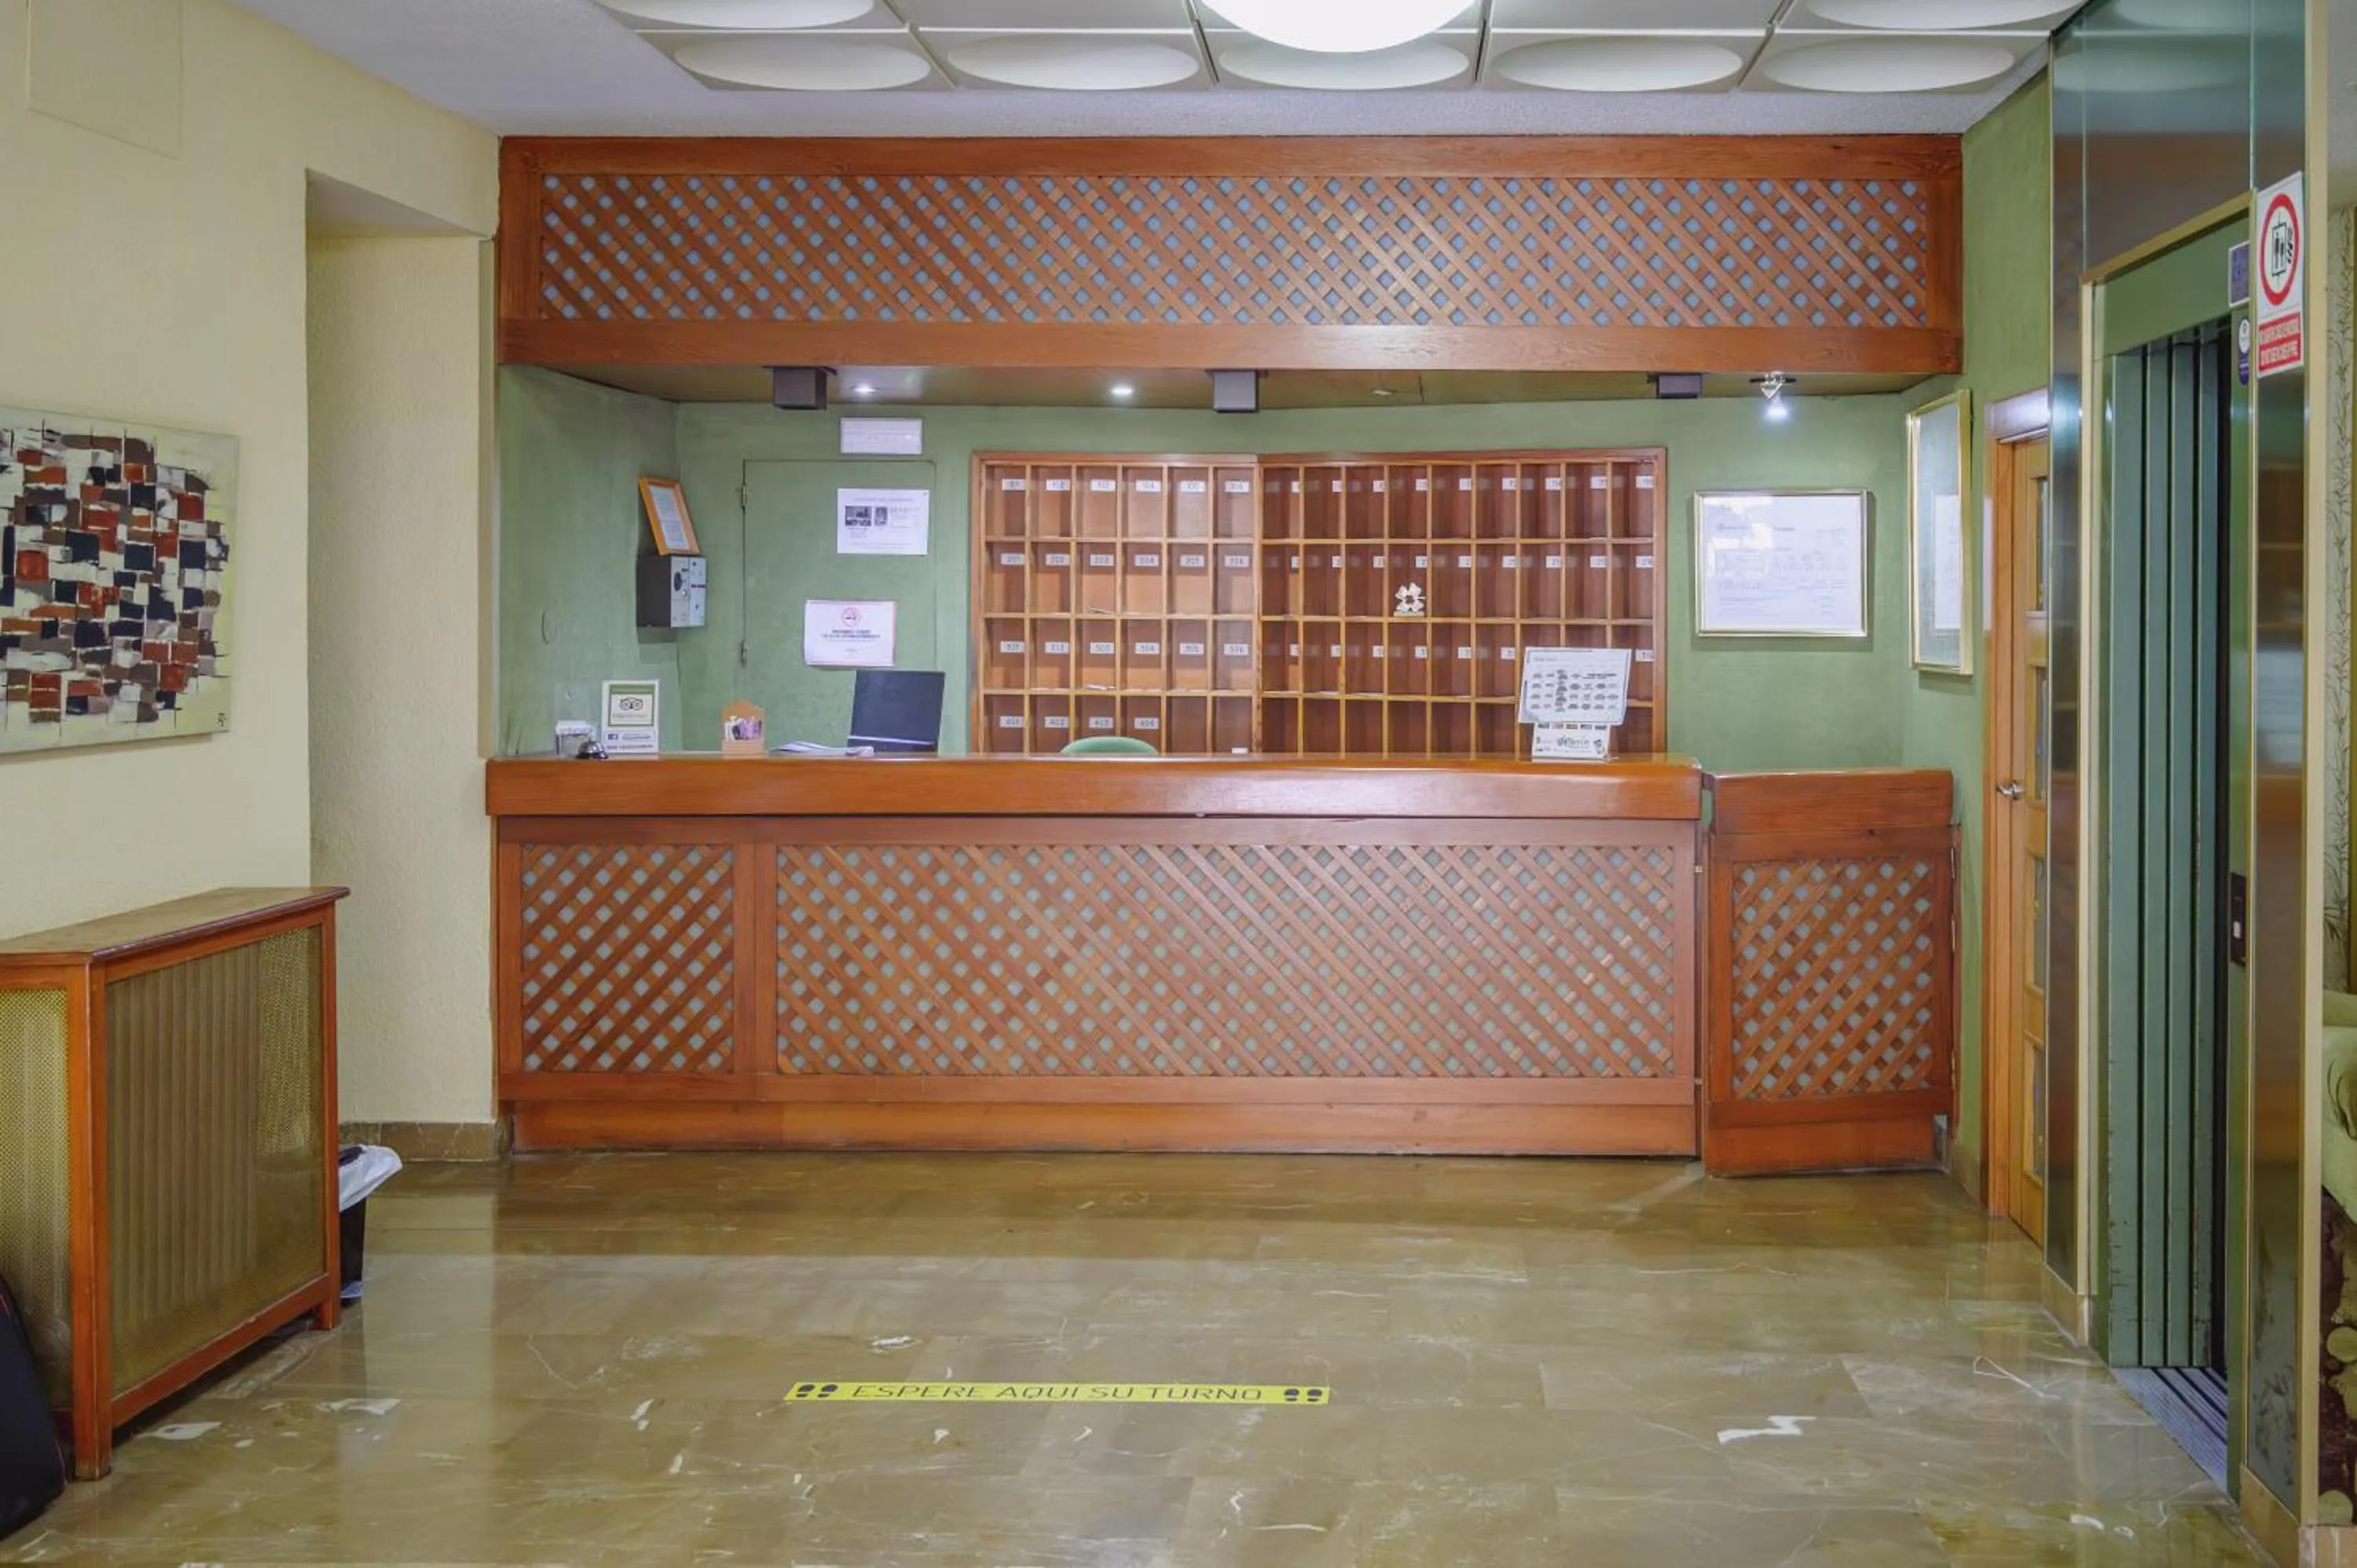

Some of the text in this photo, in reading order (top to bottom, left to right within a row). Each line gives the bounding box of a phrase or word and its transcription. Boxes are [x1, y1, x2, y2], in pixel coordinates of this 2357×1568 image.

[852, 1385, 1262, 1401] ESPERE AQUI SU TURNO
